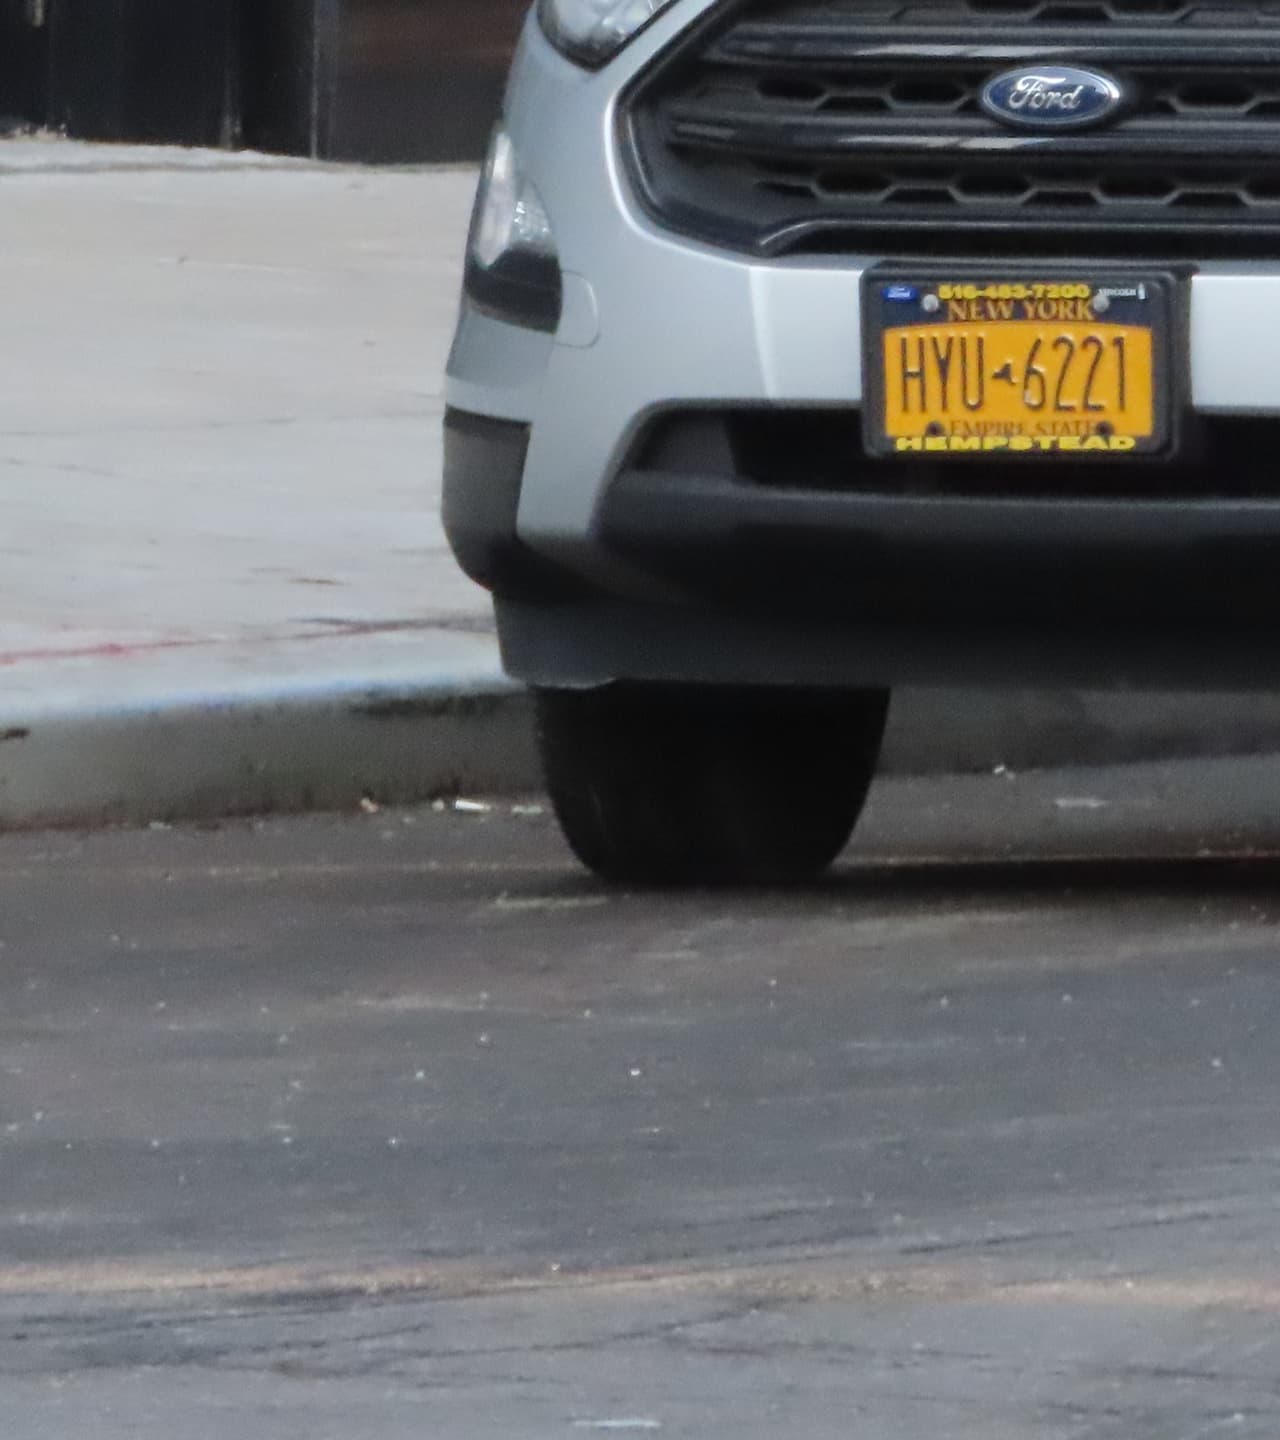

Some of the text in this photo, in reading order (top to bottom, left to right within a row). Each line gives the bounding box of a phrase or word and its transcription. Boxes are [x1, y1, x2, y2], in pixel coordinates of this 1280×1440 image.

[1008, 75, 1084, 109] Ford
[948, 298, 1094, 320] NEW YORK
[901, 336, 1126, 412] HYU 6221
[896, 436, 1136, 452] HEMPSTEAD
